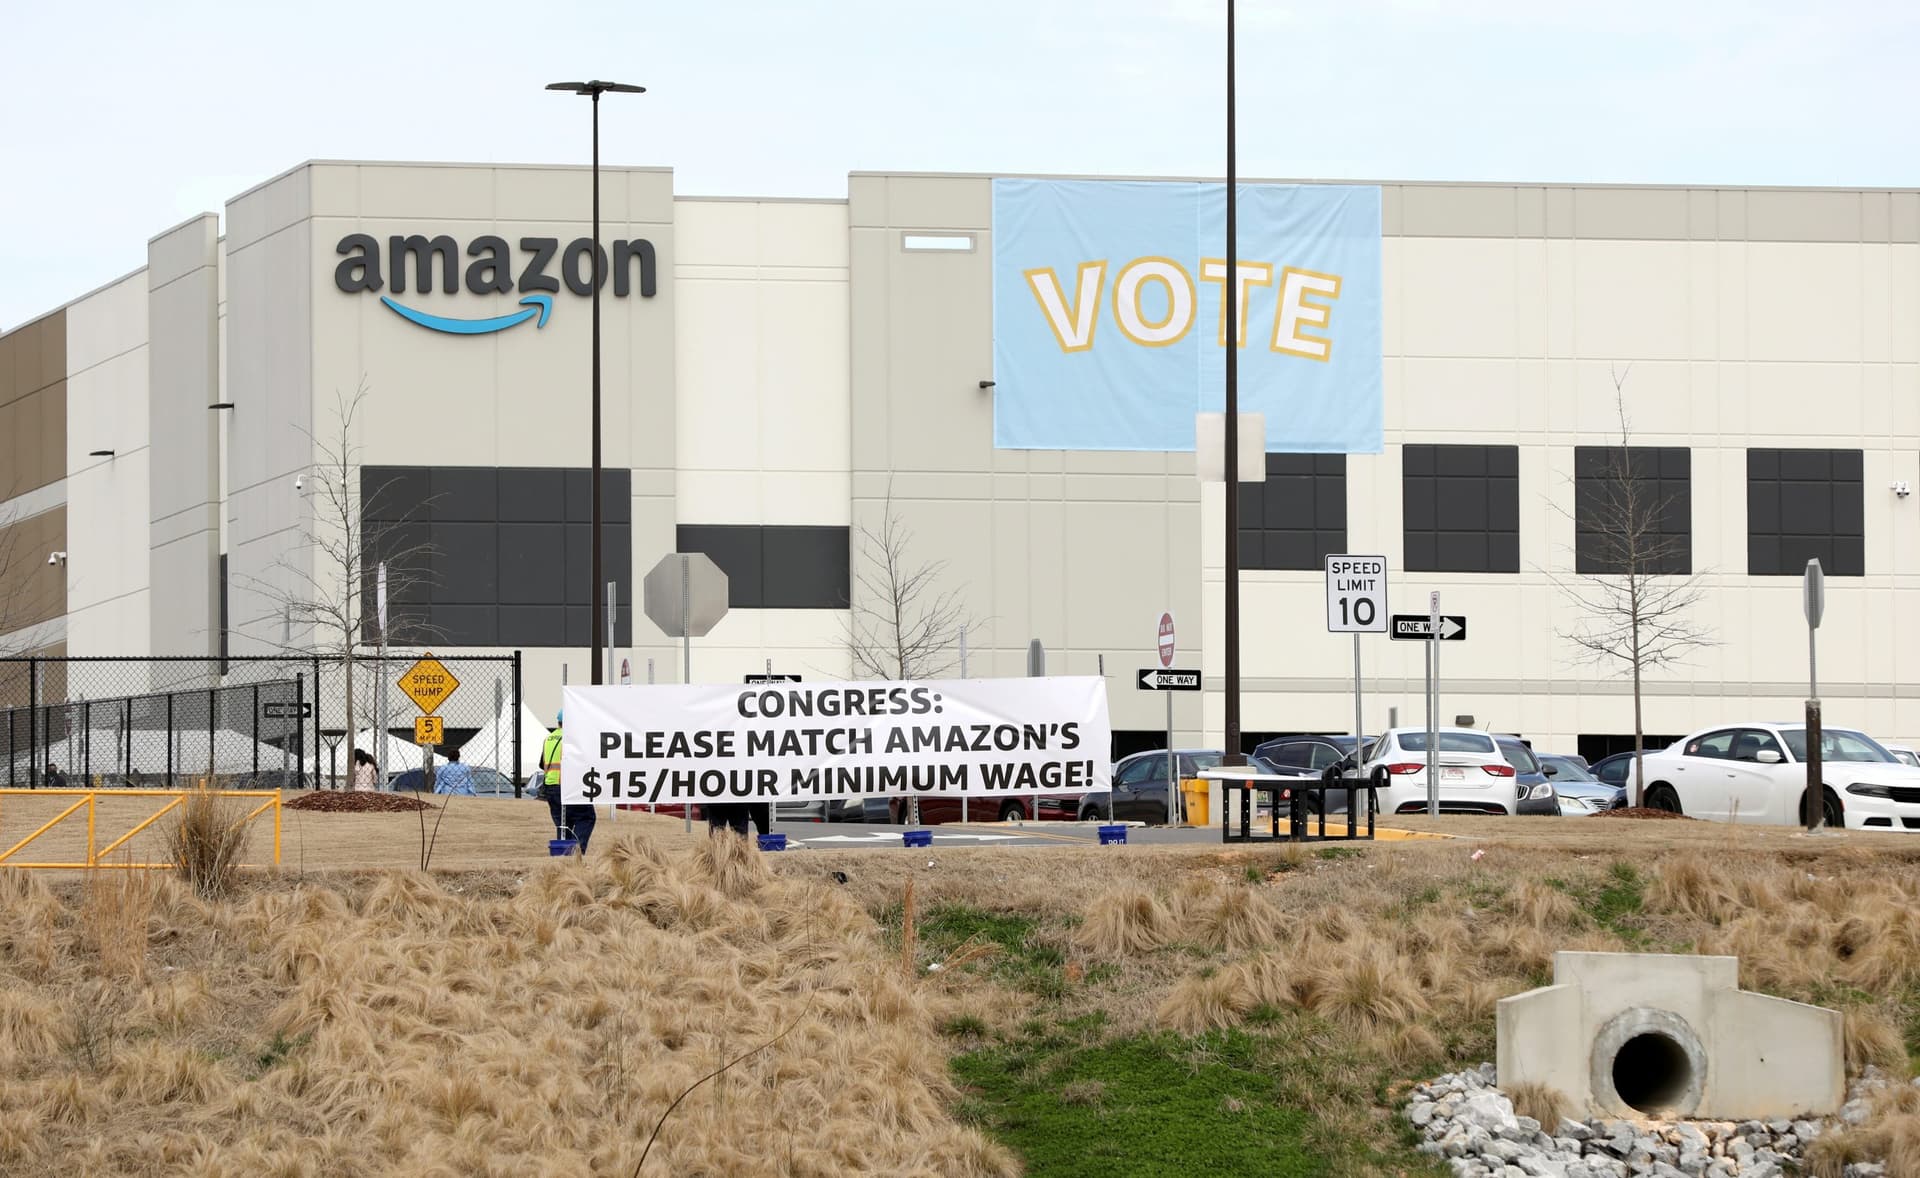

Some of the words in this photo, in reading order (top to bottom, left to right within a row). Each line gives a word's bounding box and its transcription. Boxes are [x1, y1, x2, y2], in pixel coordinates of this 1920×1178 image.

[334, 233, 657, 297] amazon
[1022, 255, 1343, 363] VOTE
[1332, 562, 1381, 574] SPEED
[1338, 579, 1376, 591] LIMIT
[1339, 597, 1375, 626] 10
[1400, 622, 1420, 632] ONE
[412, 674, 445, 685] SPEED
[1157, 675, 1174, 685] ONE
[1176, 676, 1195, 685] WAY
[414, 687, 443, 697] HUMP
[737, 687, 943, 718] CONGRESS:
[424, 719, 434, 733] 5
[600, 730, 735, 759] PLEASE
[747, 727, 872, 757] MATCH
[885, 722, 1080, 754] AMAZON'S
[582, 767, 779, 802] $15/HOUR
[791, 764, 968, 796] MINIMUM
[980, 760, 1094, 790] WAGE!
